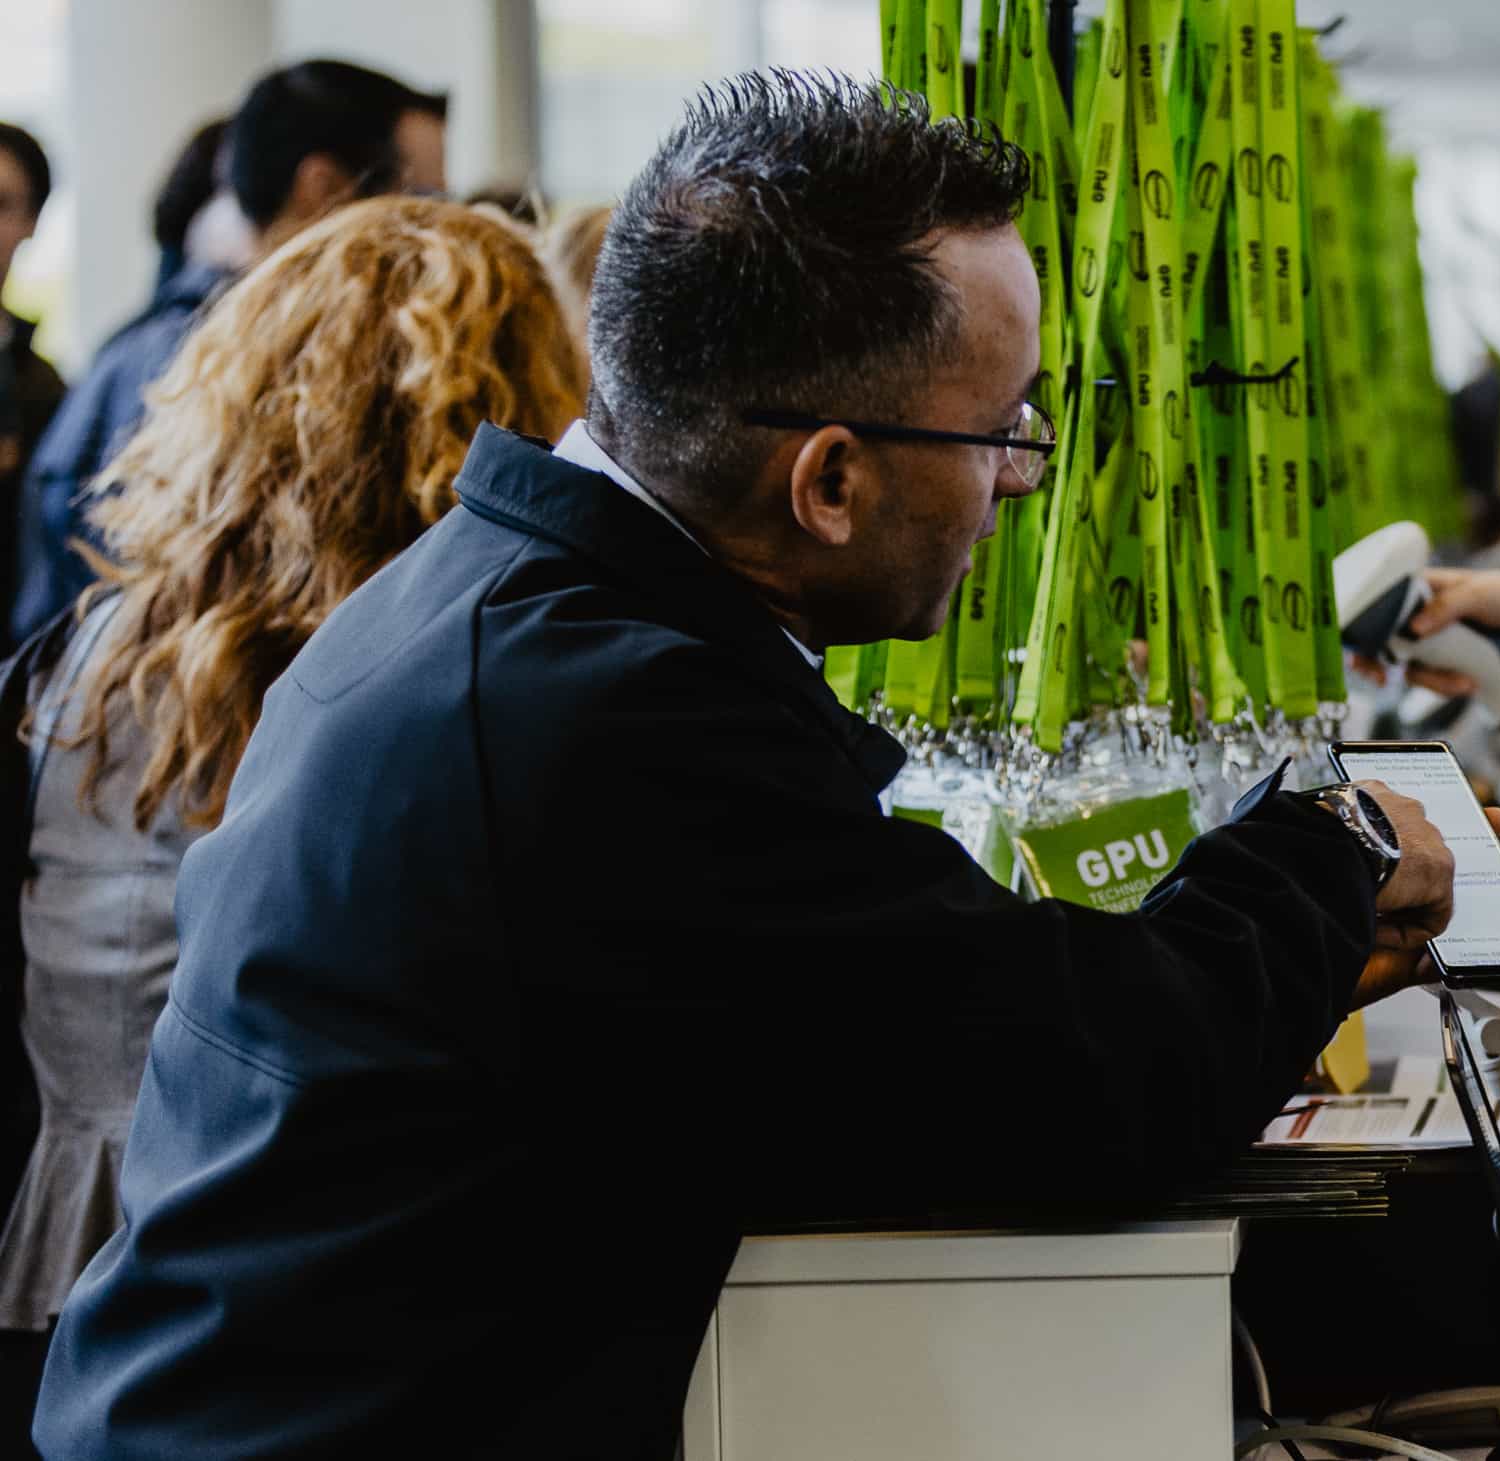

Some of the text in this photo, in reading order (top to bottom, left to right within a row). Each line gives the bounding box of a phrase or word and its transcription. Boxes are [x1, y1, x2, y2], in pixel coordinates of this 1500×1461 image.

[1092, 169, 1108, 202] GPU
[1158, 264, 1172, 297] GPU
[1076, 828, 1170, 887] GPU
